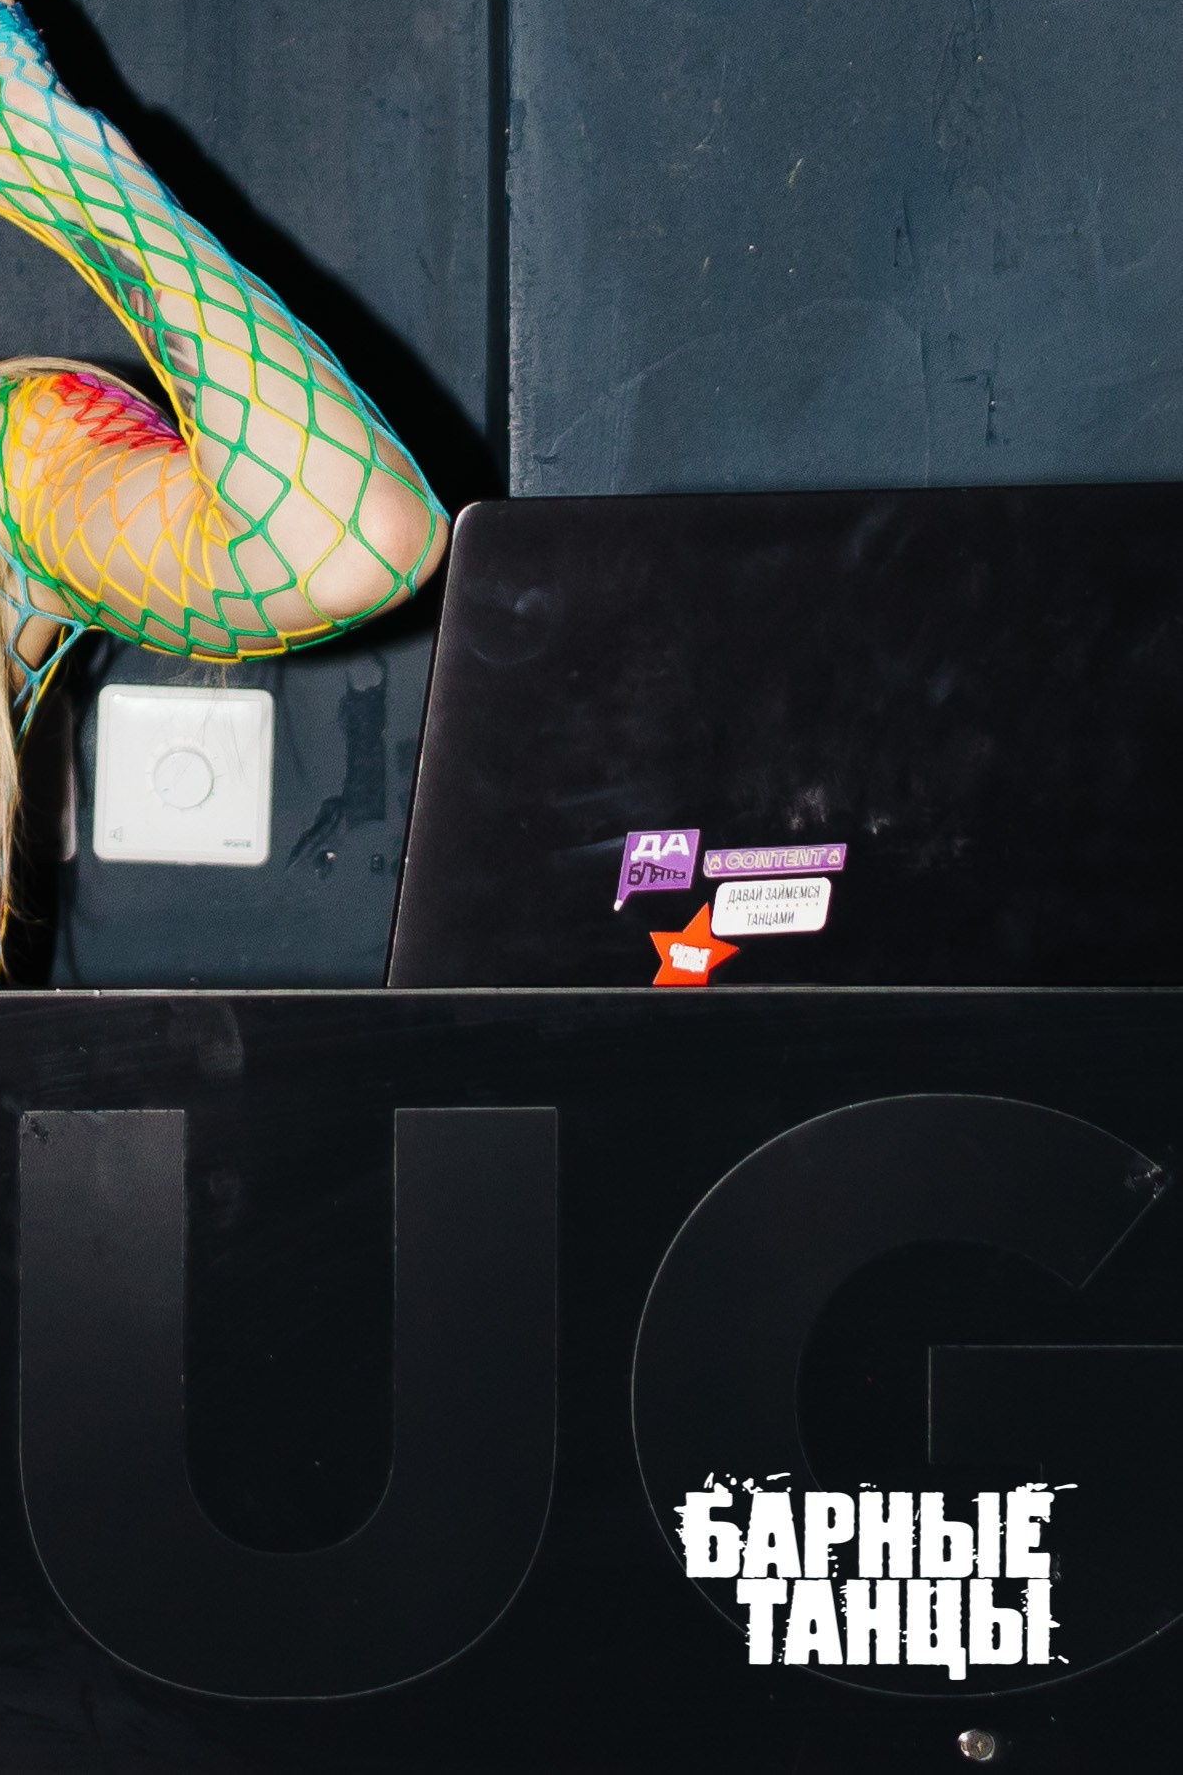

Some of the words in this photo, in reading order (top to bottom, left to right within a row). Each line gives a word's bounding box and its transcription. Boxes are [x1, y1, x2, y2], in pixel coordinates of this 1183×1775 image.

[630, 833, 690, 861] ДА
[725, 848, 826, 869] CONTENT
[727, 885, 763, 904] ДАВАЙ
[764, 883, 821, 900] ЗАЙМЕМСЯ
[747, 911, 795, 927] ТАНЦАМИ
